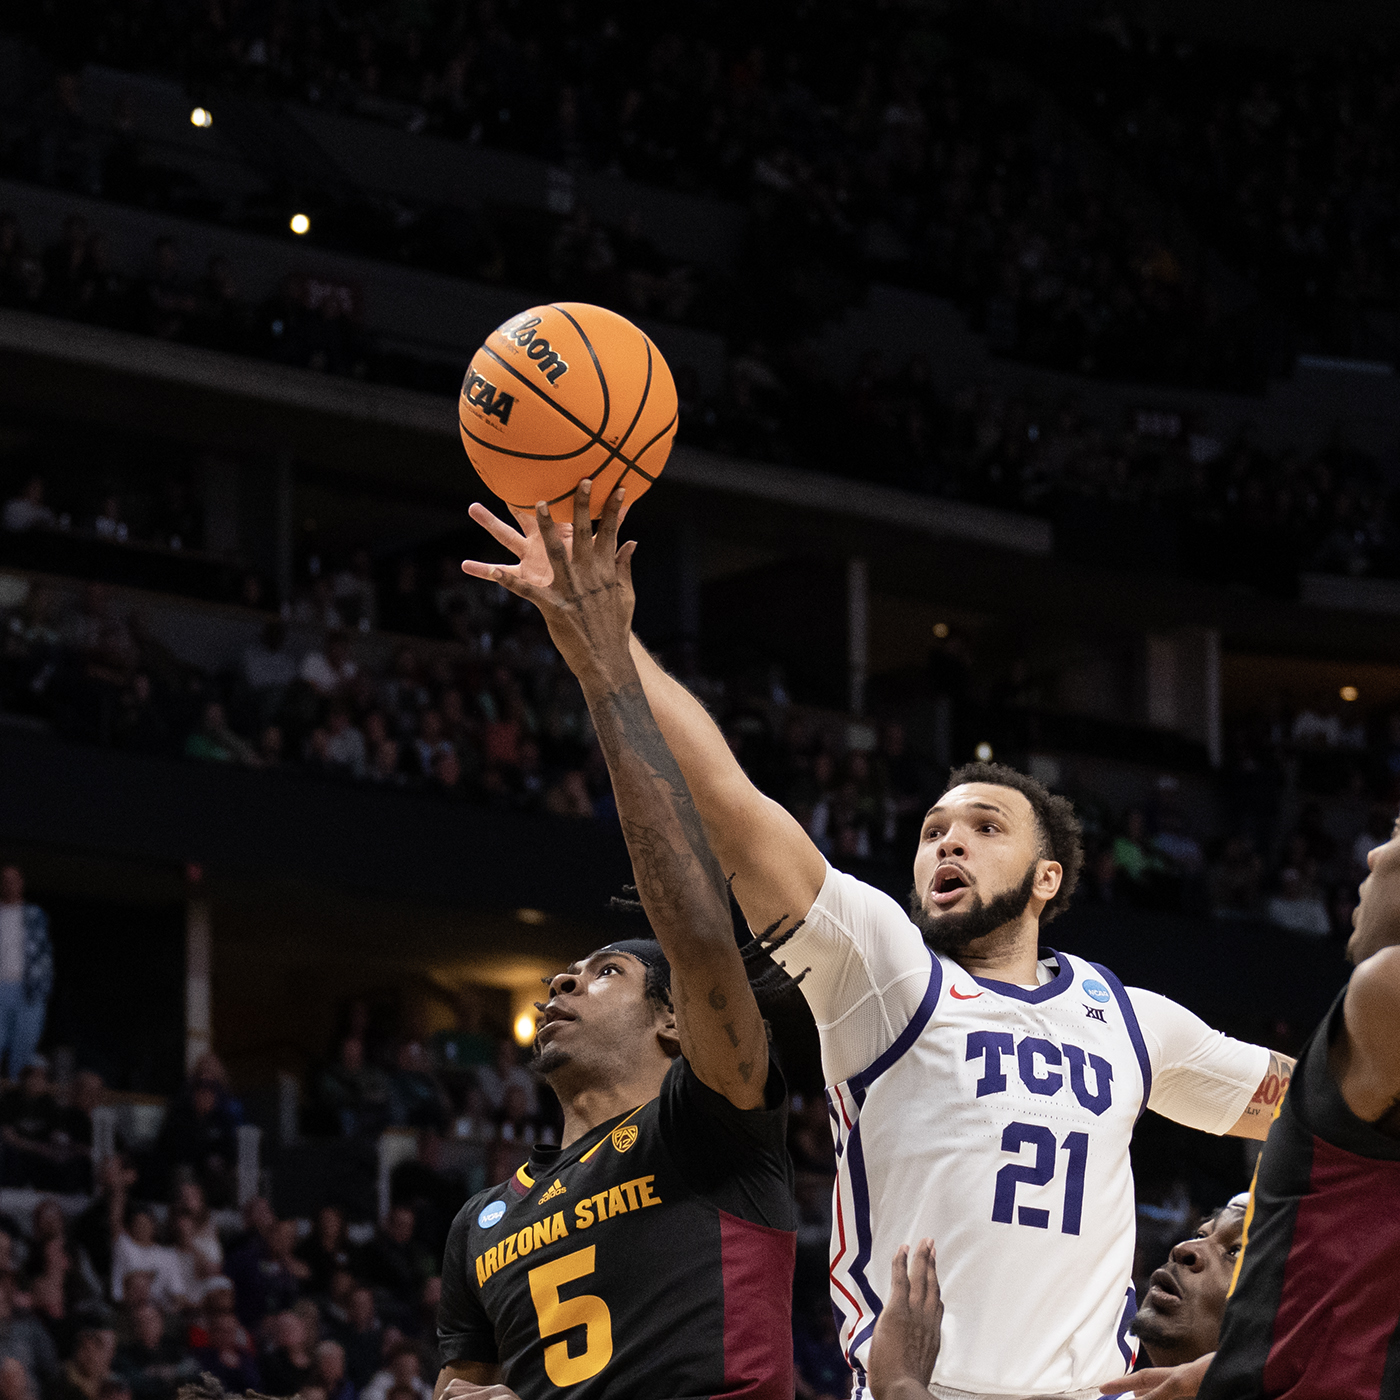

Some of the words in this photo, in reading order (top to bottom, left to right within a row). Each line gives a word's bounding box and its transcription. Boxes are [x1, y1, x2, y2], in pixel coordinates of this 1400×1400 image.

[965, 1030, 1114, 1117] TCU
[614, 1126, 637, 1144] PAC
[619, 1139, 631, 1150] 12
[991, 1121, 1089, 1236] 21
[475, 1210, 569, 1288] ARIZONA
[574, 1175, 662, 1230] STATE
[538, 1186, 567, 1205] adidas
[528, 1244, 613, 1387] 5
